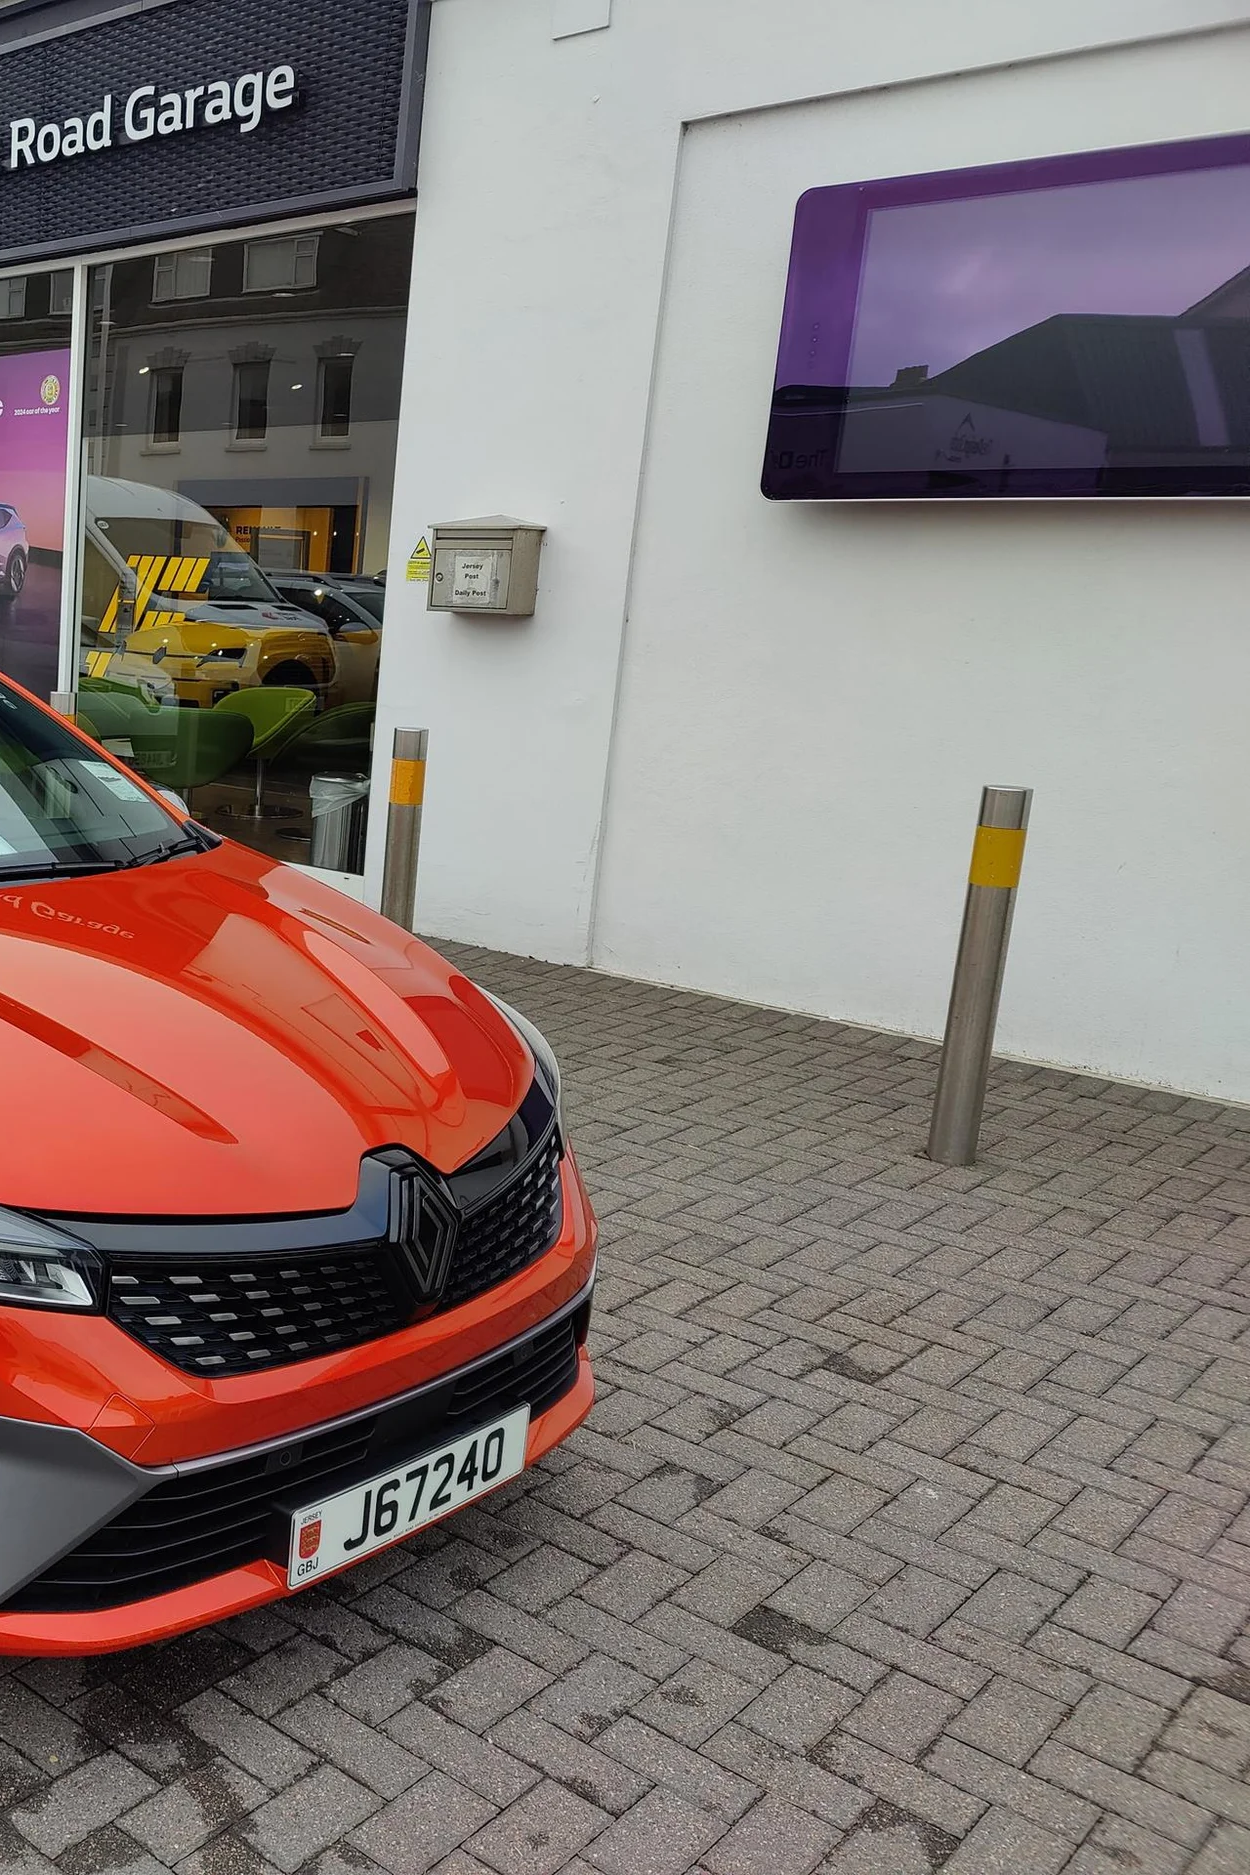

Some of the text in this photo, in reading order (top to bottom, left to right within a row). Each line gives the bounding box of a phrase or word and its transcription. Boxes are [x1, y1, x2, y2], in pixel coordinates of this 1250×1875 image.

[10, 94, 112, 169] Road
[124, 64, 296, 141] Garage
[461, 563, 484, 571] Jersey
[455, 589, 470, 597] Daily
[343, 1427, 505, 1551] J67240
[301, 1509, 323, 1526] JERSEY
[297, 1556, 319, 1577] GBJ
